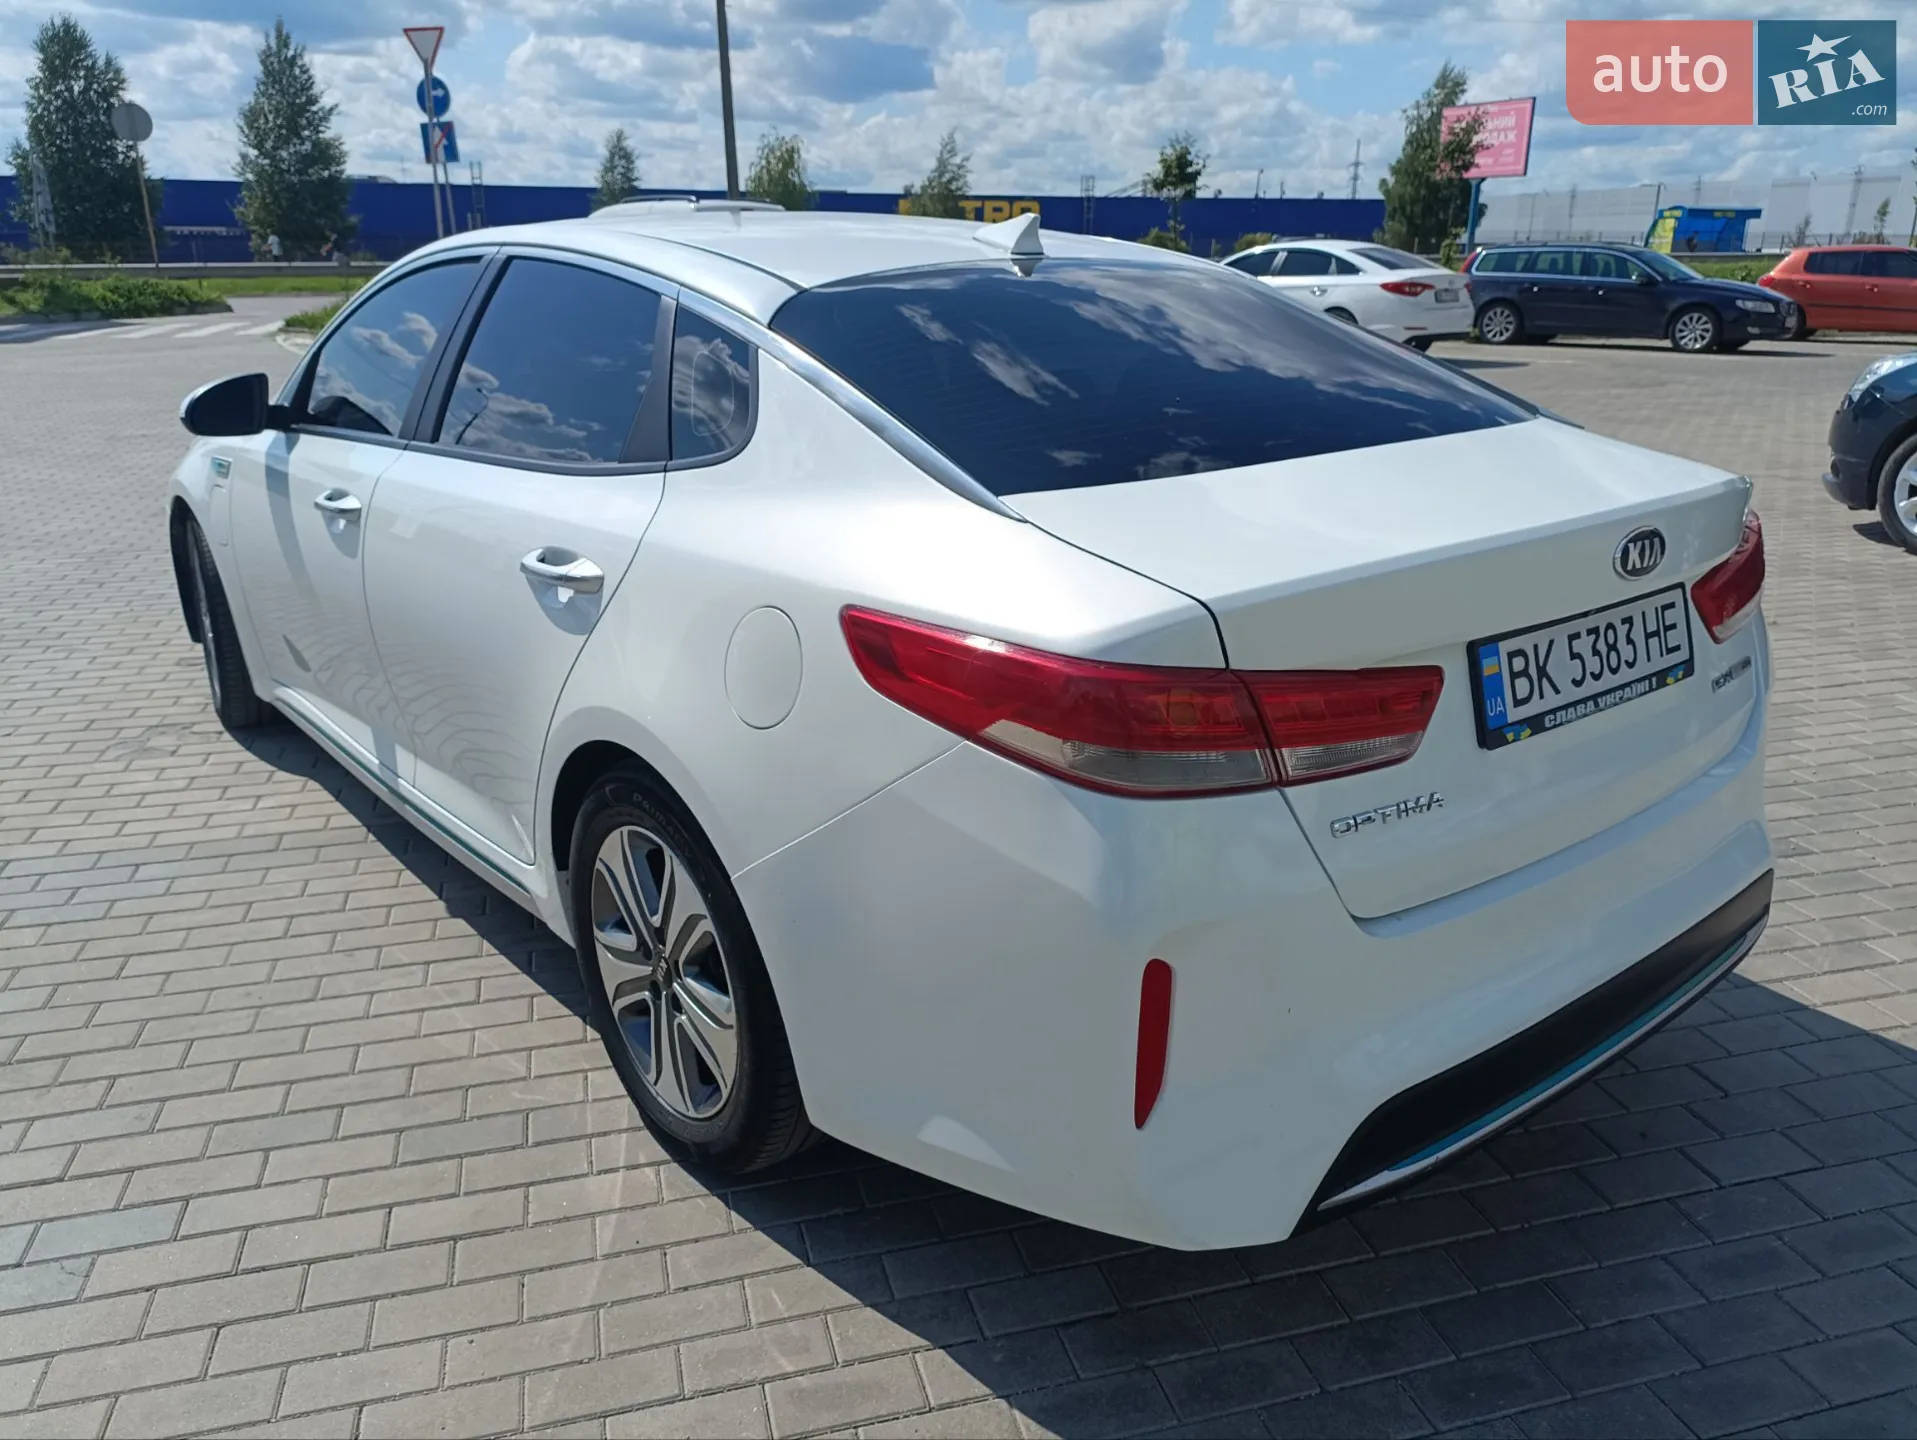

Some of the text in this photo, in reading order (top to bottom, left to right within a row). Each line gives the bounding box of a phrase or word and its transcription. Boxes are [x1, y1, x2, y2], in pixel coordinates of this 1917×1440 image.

[1626, 536, 1663, 571] KIA
[1506, 639, 1562, 709] BK
[1566, 615, 1638, 689] 5383
[1641, 601, 1682, 663] HE
[1487, 697, 1505, 717] UA
[1544, 699, 1596, 728] СЛАВА
[1330, 791, 1445, 838] OPTIMA
